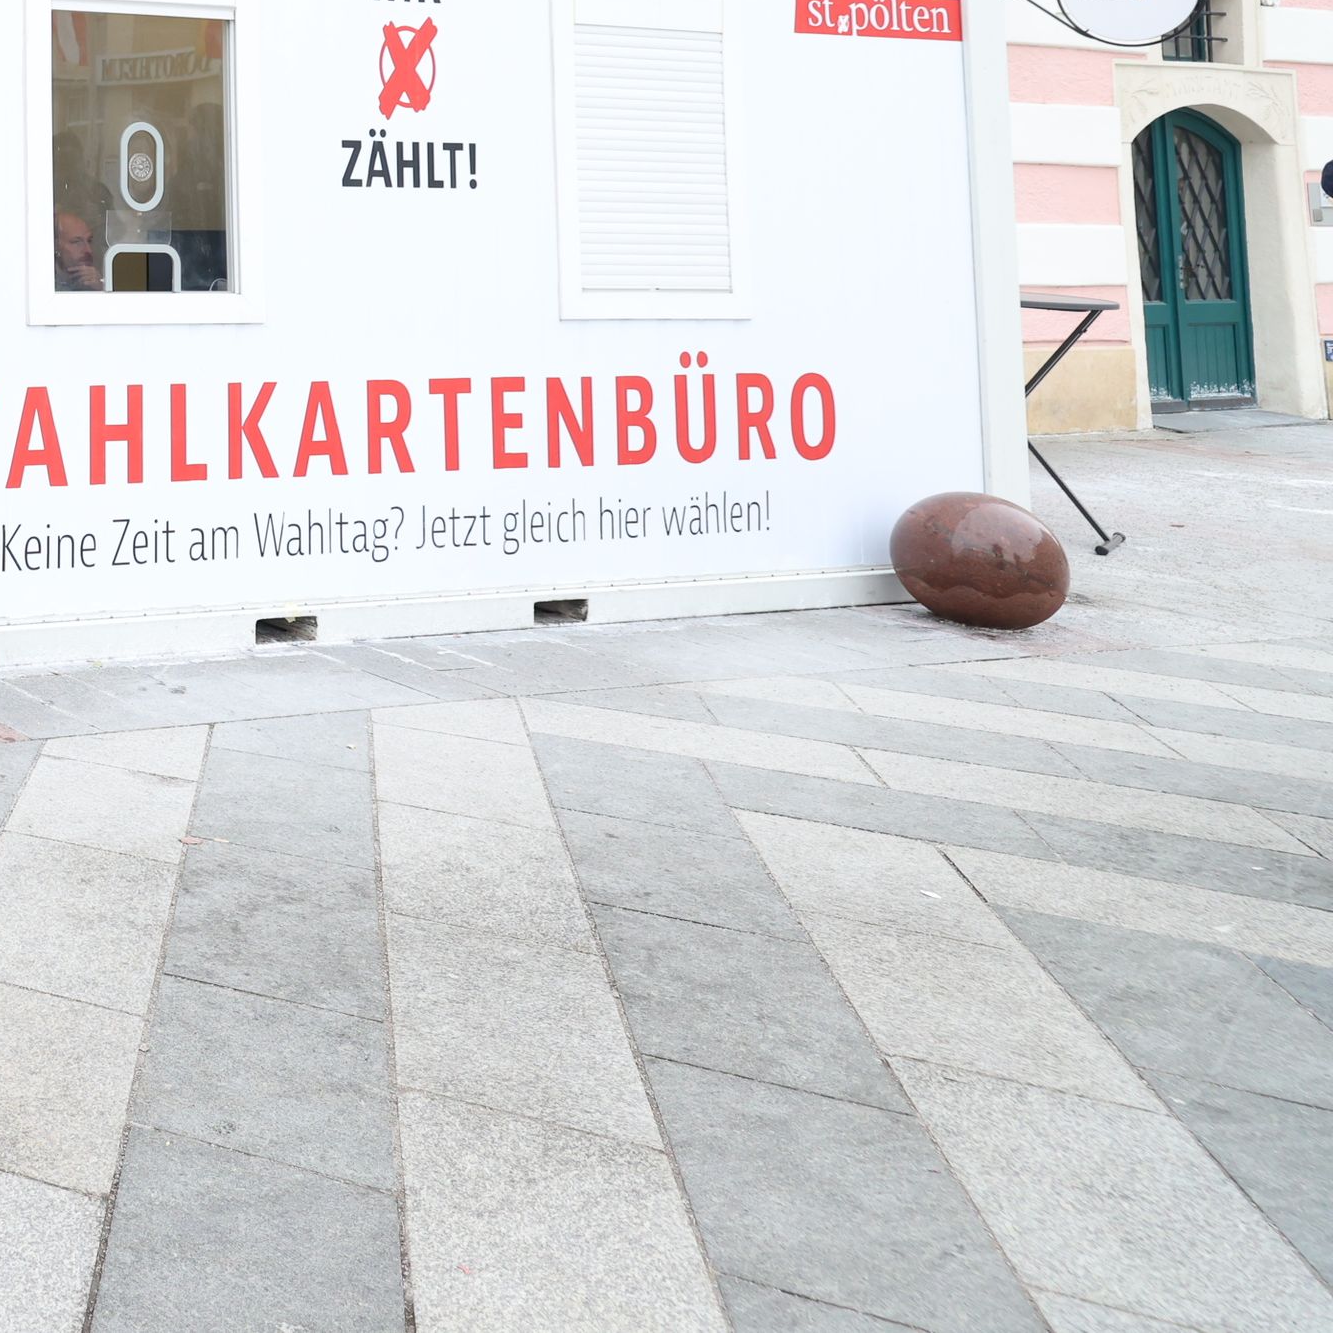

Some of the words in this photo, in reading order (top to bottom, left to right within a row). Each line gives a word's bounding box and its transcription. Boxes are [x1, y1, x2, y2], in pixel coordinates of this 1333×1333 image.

[341, 128, 477, 190] ZÄHLT!
[0, 521, 98, 573] Keine
[110, 517, 177, 568] Zeit
[188, 523, 240, 563] am
[253, 506, 405, 563] Wahltag?
[416, 504, 493, 551] Jetzt
[502, 497, 587, 556] gleich
[599, 496, 652, 541] hier
[662, 489, 771, 538] wählen!
